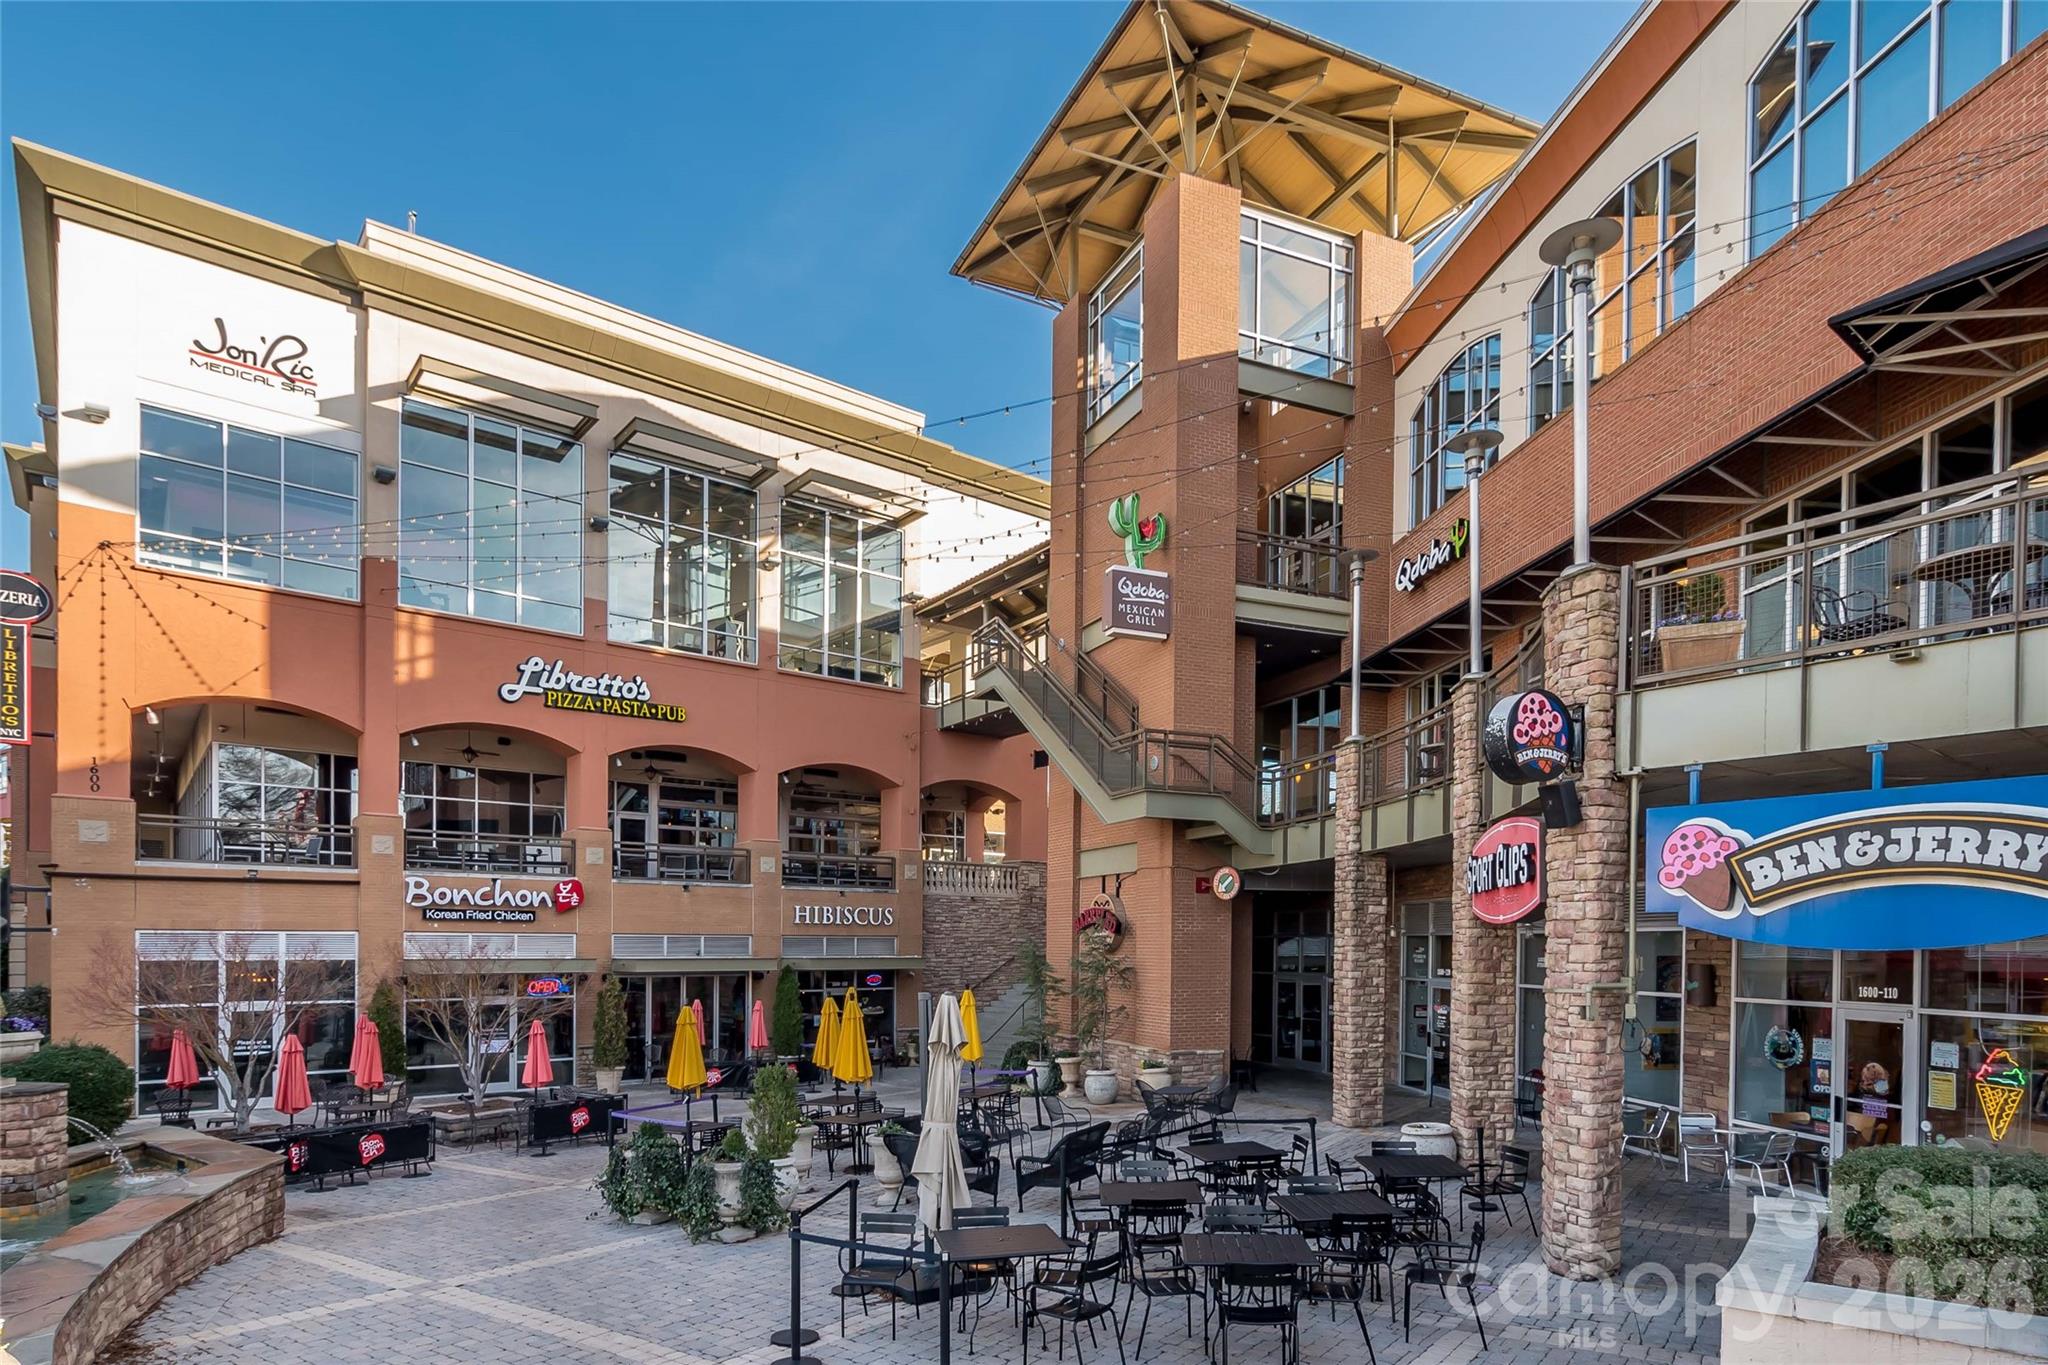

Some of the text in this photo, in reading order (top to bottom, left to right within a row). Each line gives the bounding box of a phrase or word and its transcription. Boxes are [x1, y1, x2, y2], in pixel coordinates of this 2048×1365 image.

[190, 357, 317, 399] MEDICAL SPA
[1395, 539, 1451, 591] Qdoba
[1117, 576, 1165, 600] Qdoba
[1118, 603, 1165, 618] MEXICAN
[1126, 614, 1156, 626] GRILL
[500, 656, 651, 702] Libretto's
[0, 728, 22, 738] NYC
[90, 756, 100, 792] 1600
[1467, 842, 1528, 895] SPORT CLIPS
[405, 876, 553, 908] Bonchon
[426, 909, 534, 921] Korean Fried Chicken
[794, 905, 894, 926] HIBISCUS
[528, 980, 559, 993] OPEN
[1858, 986, 1899, 999] 1600-110
